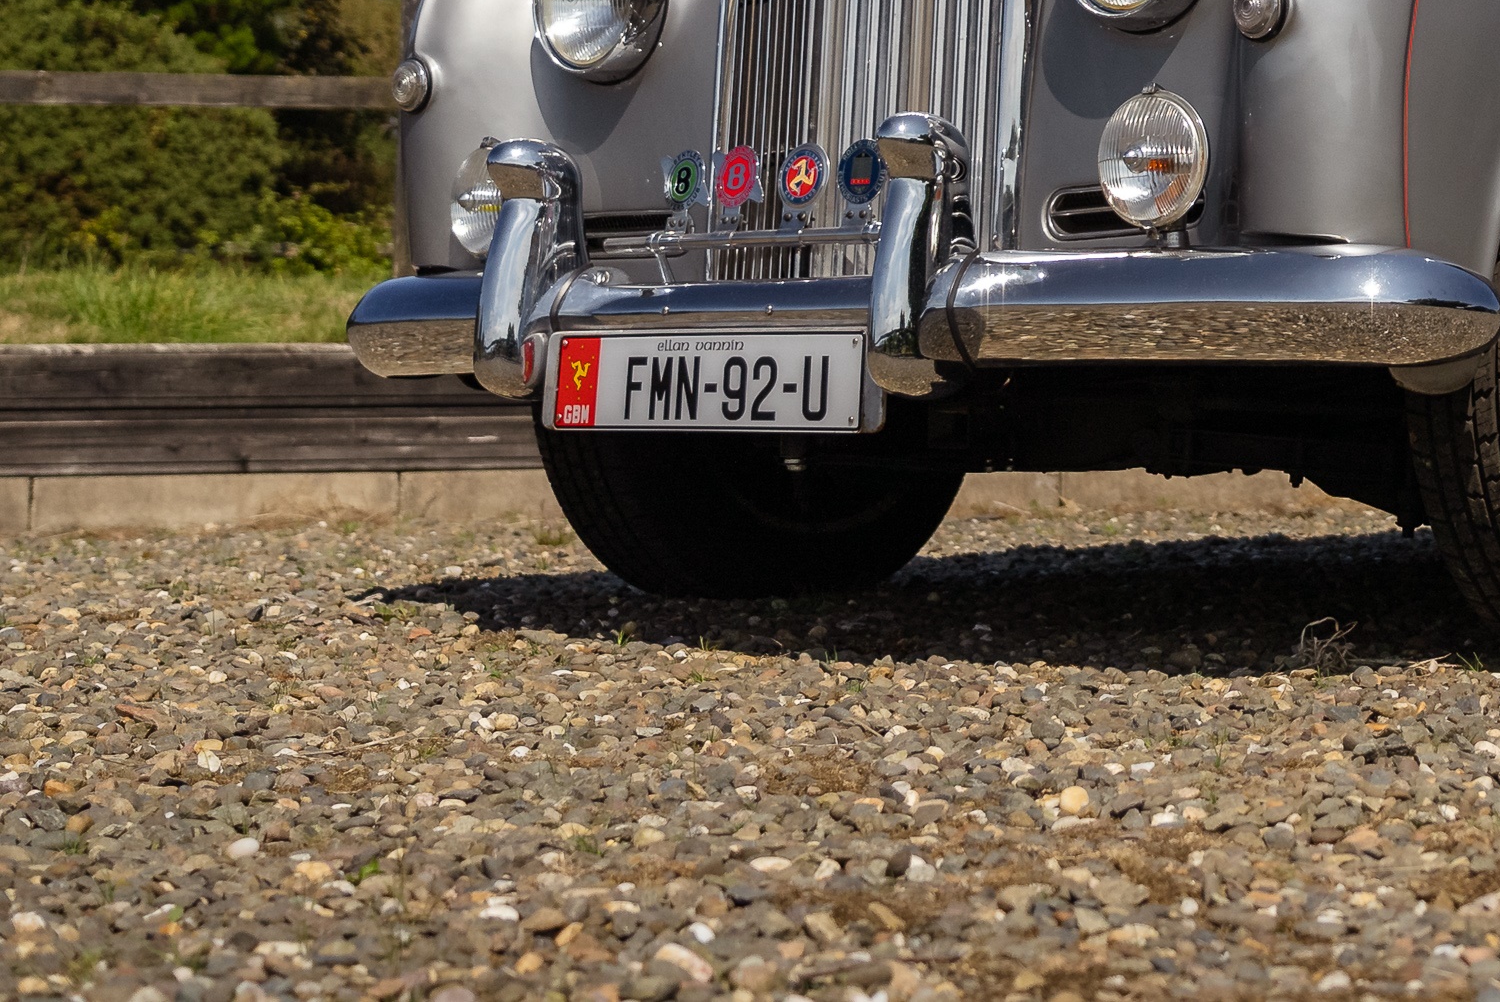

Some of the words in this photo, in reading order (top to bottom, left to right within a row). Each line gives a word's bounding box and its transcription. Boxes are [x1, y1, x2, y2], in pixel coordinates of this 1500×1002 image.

[727, 163, 746, 190] B
[686, 188, 701, 206] CLUB
[801, 189, 816, 202] CLUB
[657, 339, 690, 352] ellan
[695, 339, 744, 352] vannin
[623, 355, 829, 421] FMN-92-U
[563, 405, 590, 424] GBM
